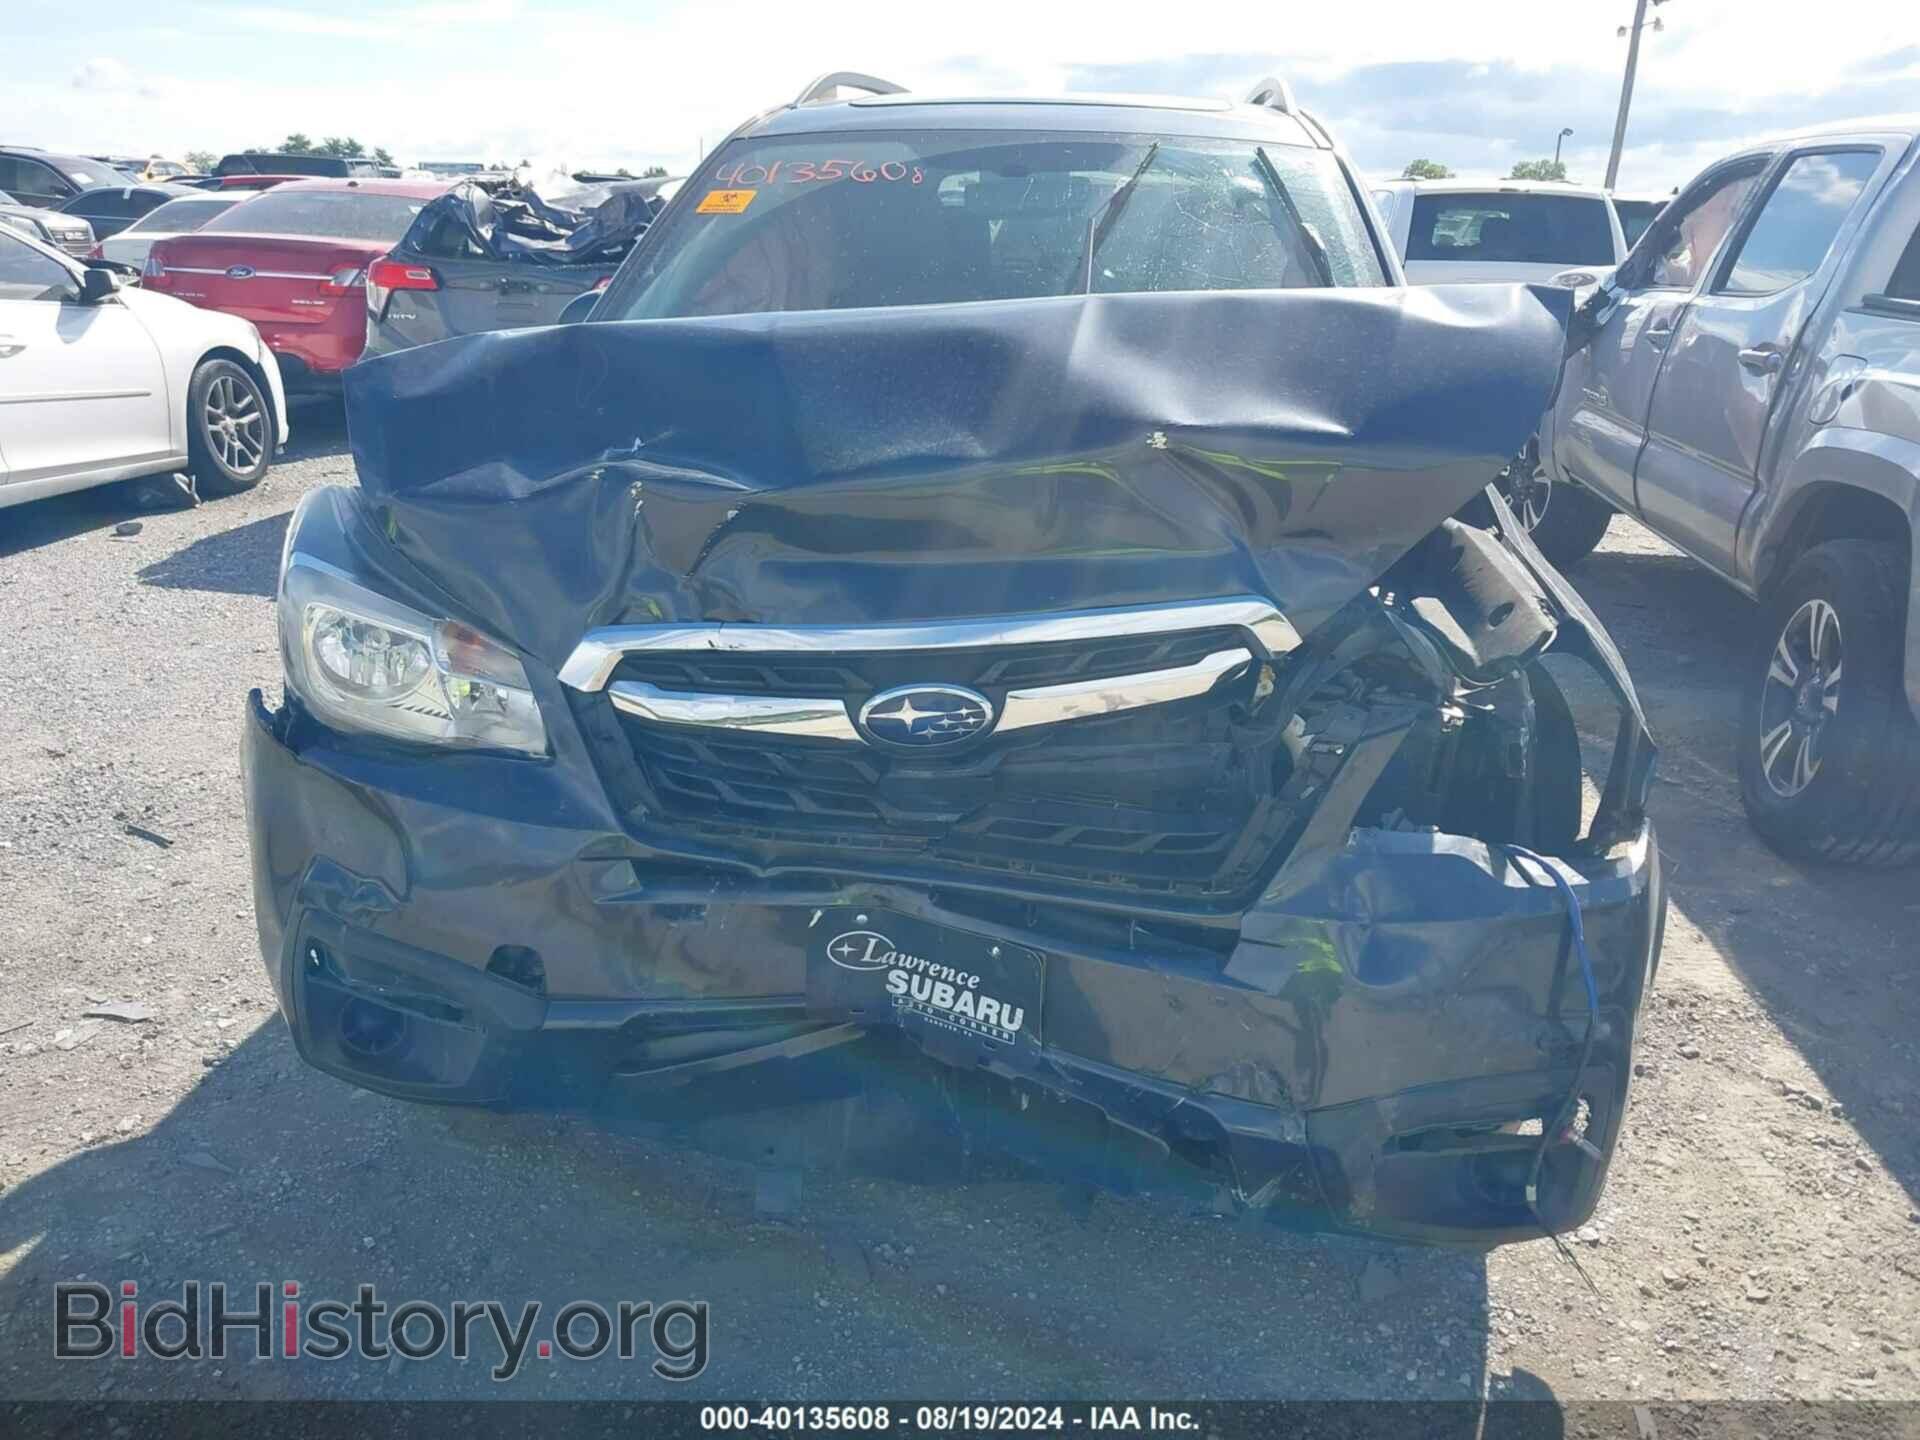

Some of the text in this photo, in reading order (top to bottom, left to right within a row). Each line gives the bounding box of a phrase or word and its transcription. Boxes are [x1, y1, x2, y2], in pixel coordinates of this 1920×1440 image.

[716, 160, 925, 187] 40135608
[861, 938, 980, 988] Lawrence
[885, 969, 1024, 1031] SUBARU
[948, 1013, 1010, 1040] CORNER
